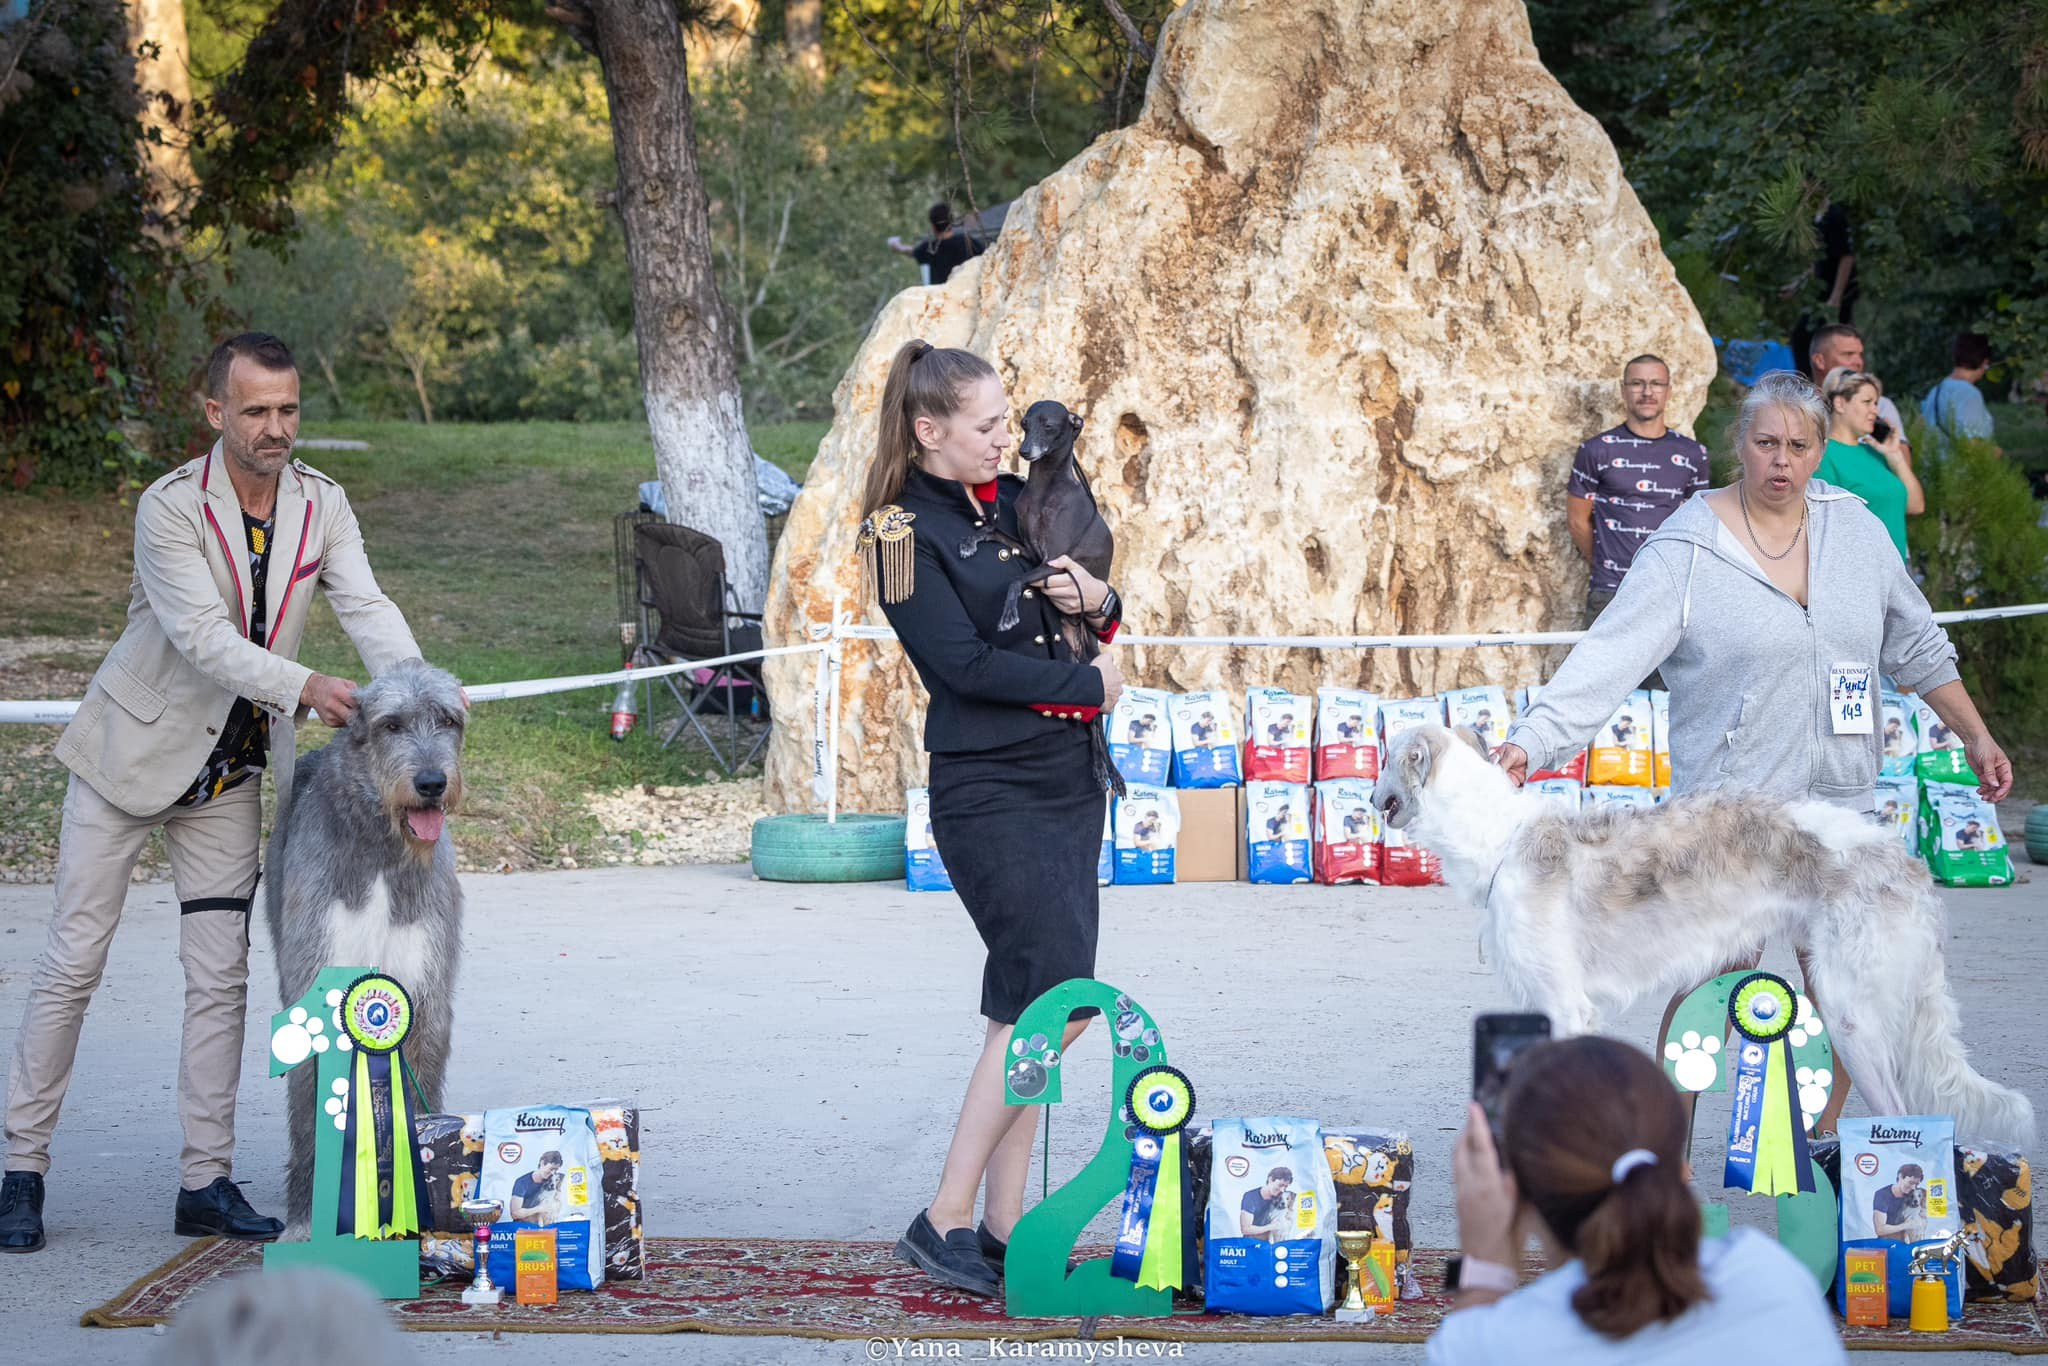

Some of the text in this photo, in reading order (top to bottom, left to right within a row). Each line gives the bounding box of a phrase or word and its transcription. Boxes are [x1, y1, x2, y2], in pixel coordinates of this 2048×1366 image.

[1611, 457, 1661, 473] Champion
[1635, 479, 1683, 499] Champi
[515, 1112, 566, 1136] Karmy
[1241, 1127, 1293, 1151] Karmy
[1869, 1124, 1923, 1149] Karmy
[1004, 978, 1173, 1317] 2
[525, 1240, 547, 1249] PET
[1219, 1247, 1246, 1257] MAXI
[1371, 1249, 1394, 1266] ET
[518, 1262, 554, 1271] BRUSH
[1855, 1261, 1876, 1271] PET
[1847, 1283, 1885, 1294] BRUSH
[1363, 1294, 1392, 1303] RUSH
